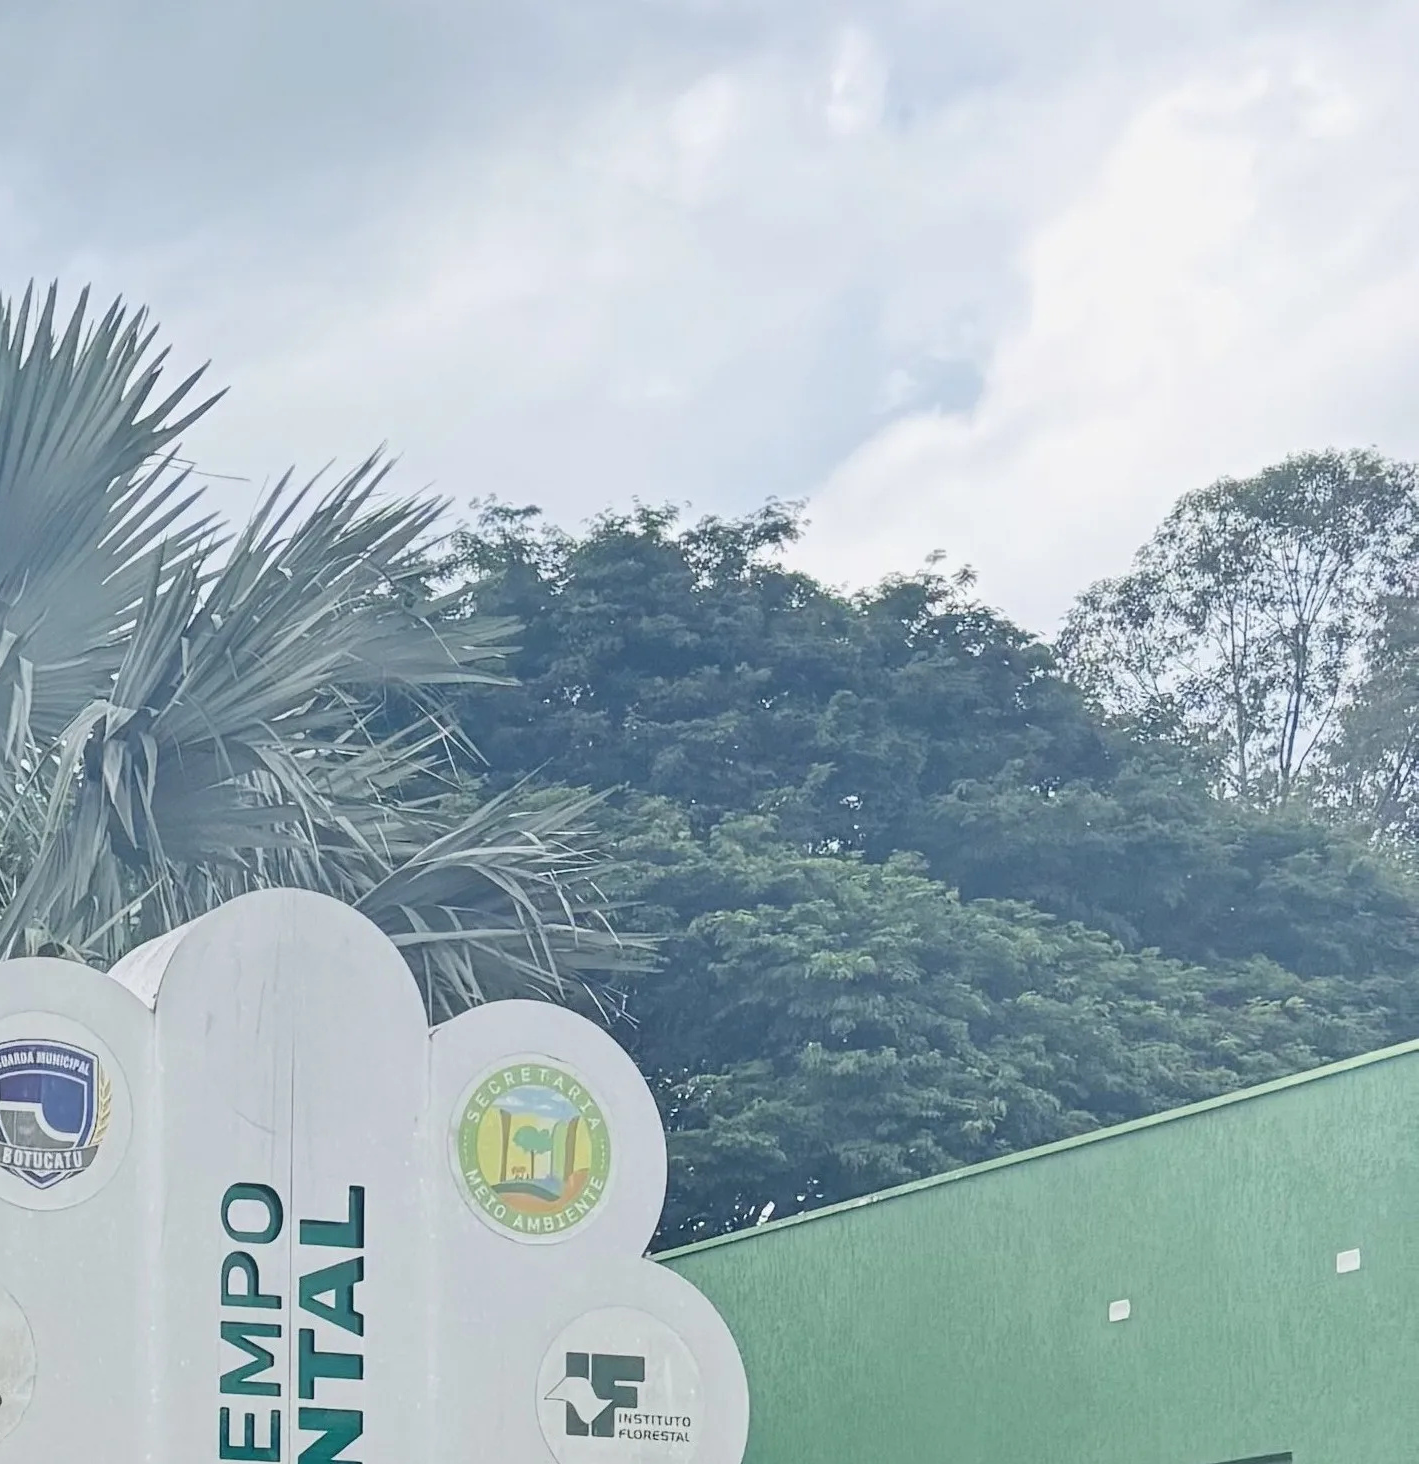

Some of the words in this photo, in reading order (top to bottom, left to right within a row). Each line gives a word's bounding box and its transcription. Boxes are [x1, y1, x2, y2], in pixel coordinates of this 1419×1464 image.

[36, 1050, 90, 1076] MUNICIPAL
[467, 1067, 601, 1131] SECRETARIA
[2, 1149, 83, 1169] BOTUCATU
[466, 1168, 507, 1220] MEIO
[512, 1176, 604, 1233] AMBIENTE
[618, 1413, 691, 1428] INSTITUTO
[618, 1428, 690, 1443] FLORESTAL
